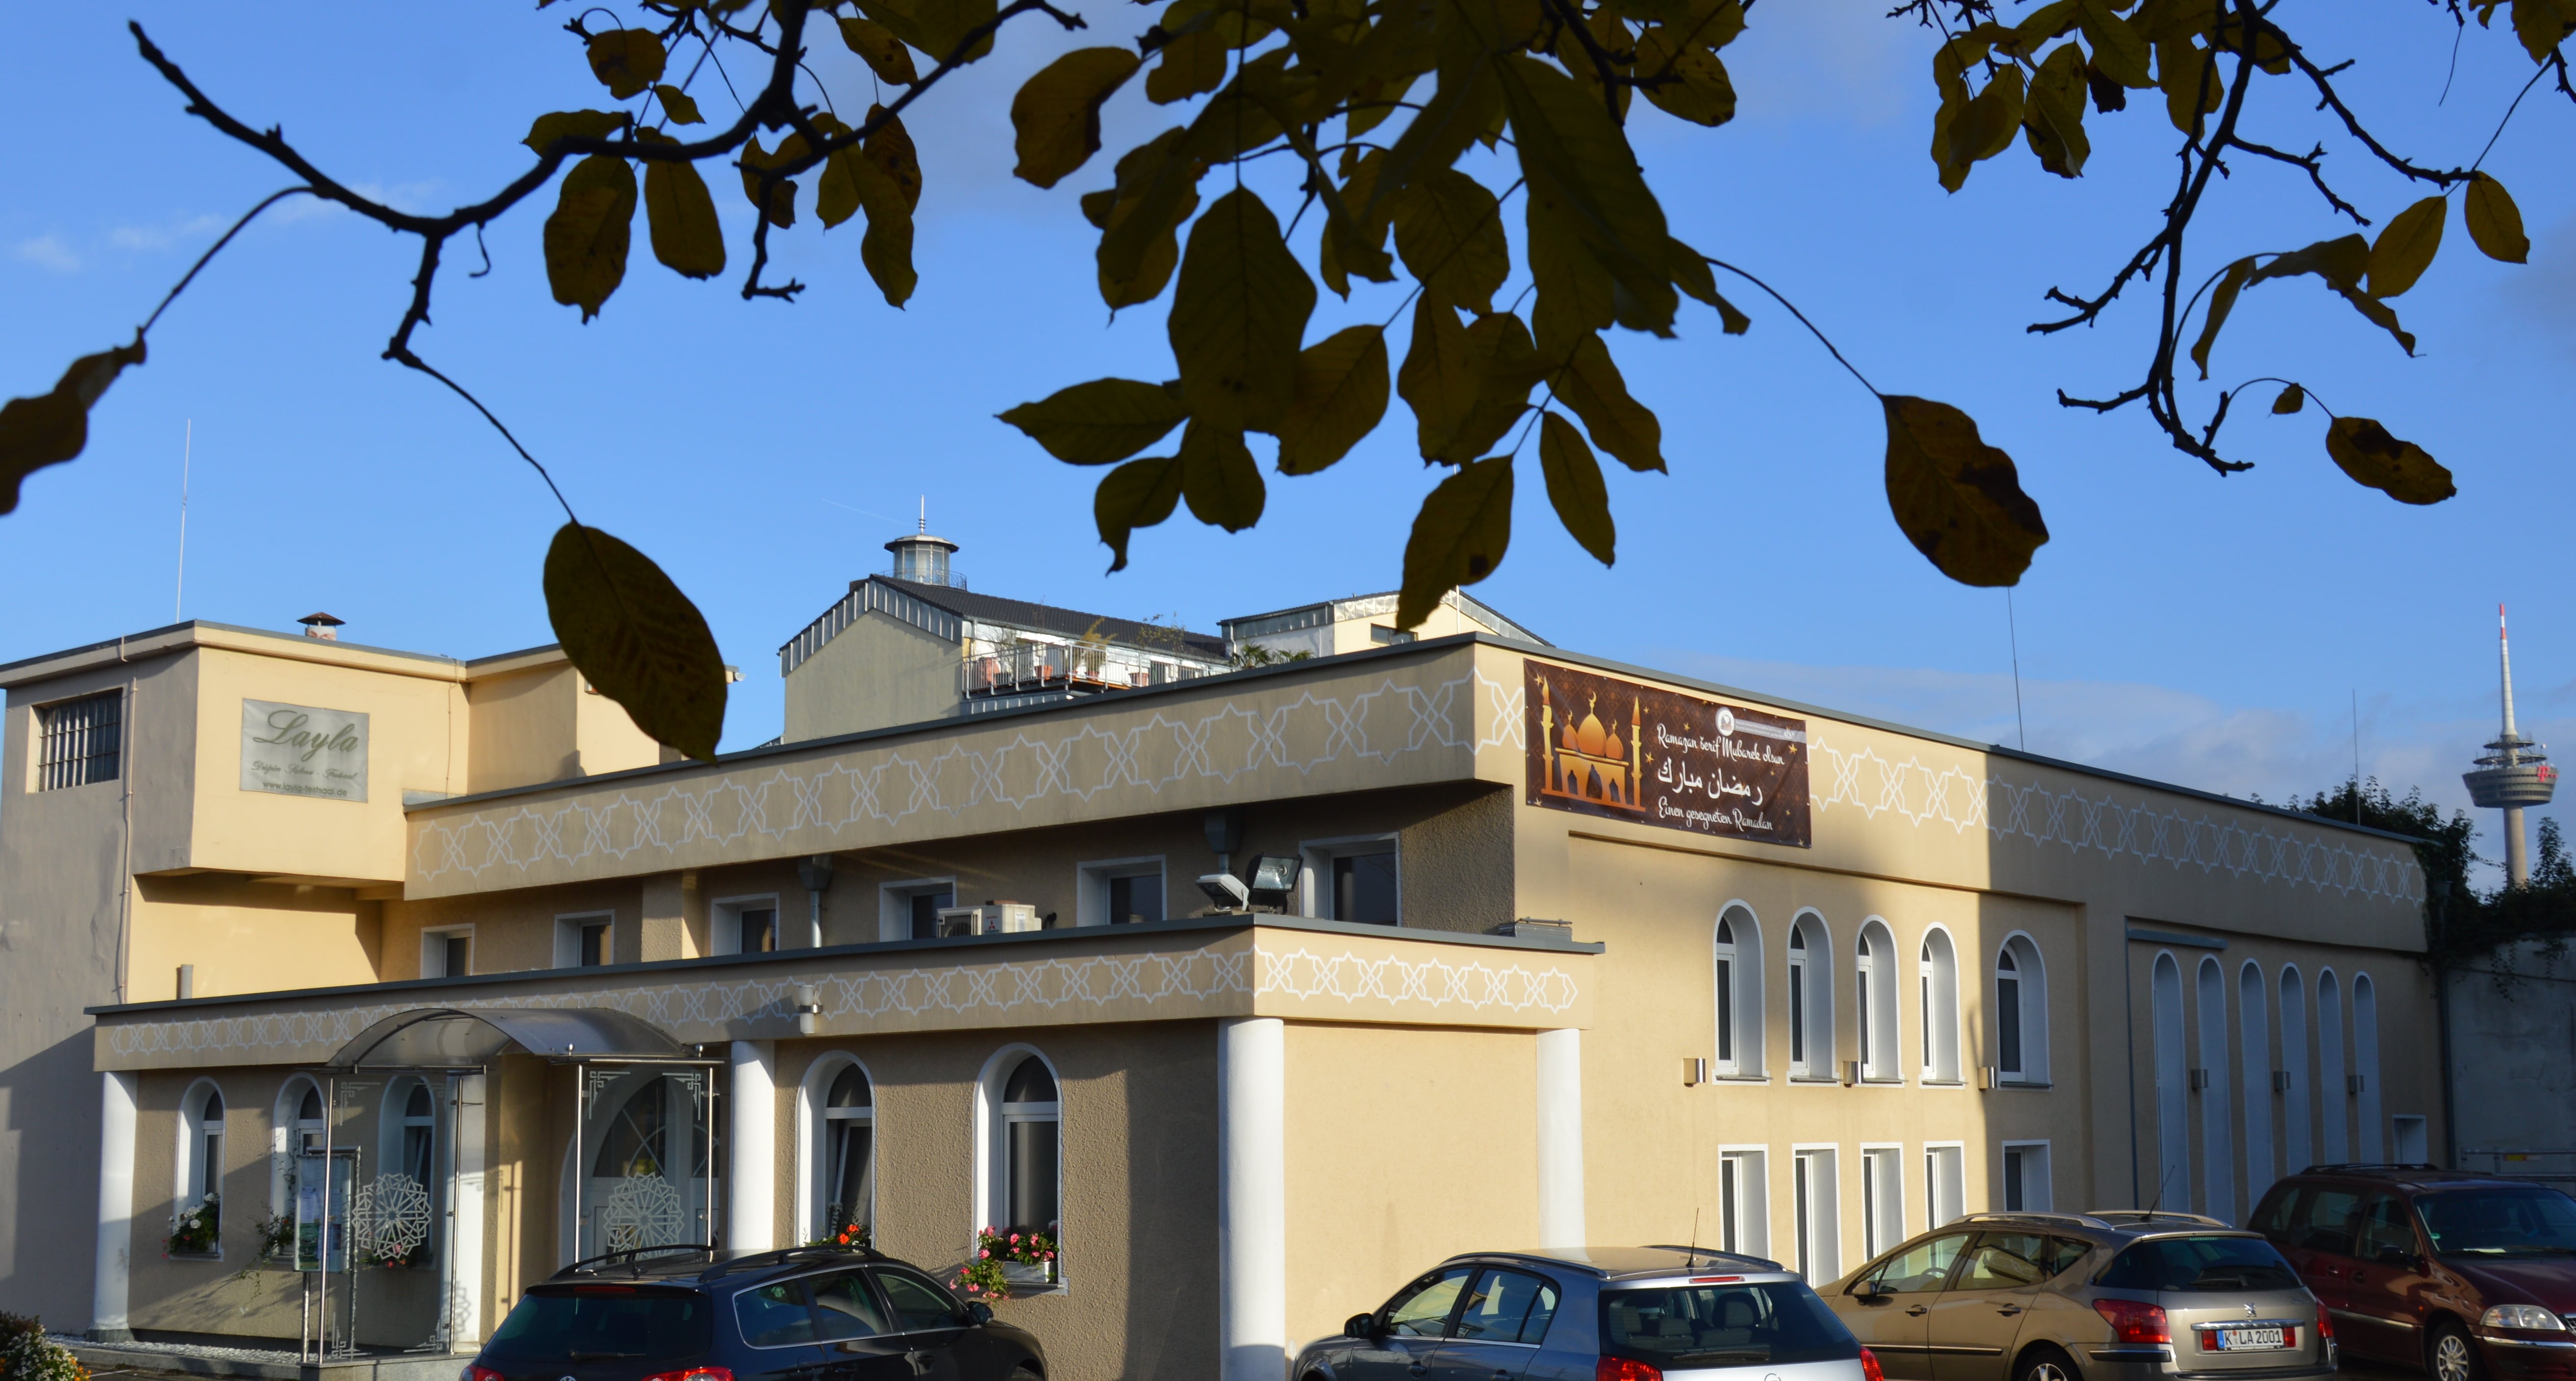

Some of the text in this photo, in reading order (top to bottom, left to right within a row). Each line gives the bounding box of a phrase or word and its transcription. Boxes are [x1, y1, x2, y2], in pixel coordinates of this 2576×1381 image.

[253, 709, 358, 762] Layla
[1657, 723, 1698, 753] Ramazan
[1722, 737, 1761, 762] Mubarek
[1762, 745, 1785, 765] olsun
[263, 781, 348, 796] www.layla-festsaal.de
[1658, 756, 1763, 806] رمضان مبارك
[1658, 796, 1774, 832] Einen gesegneten Ramadan
[2224, 1330, 2282, 1345] K LA 2001
